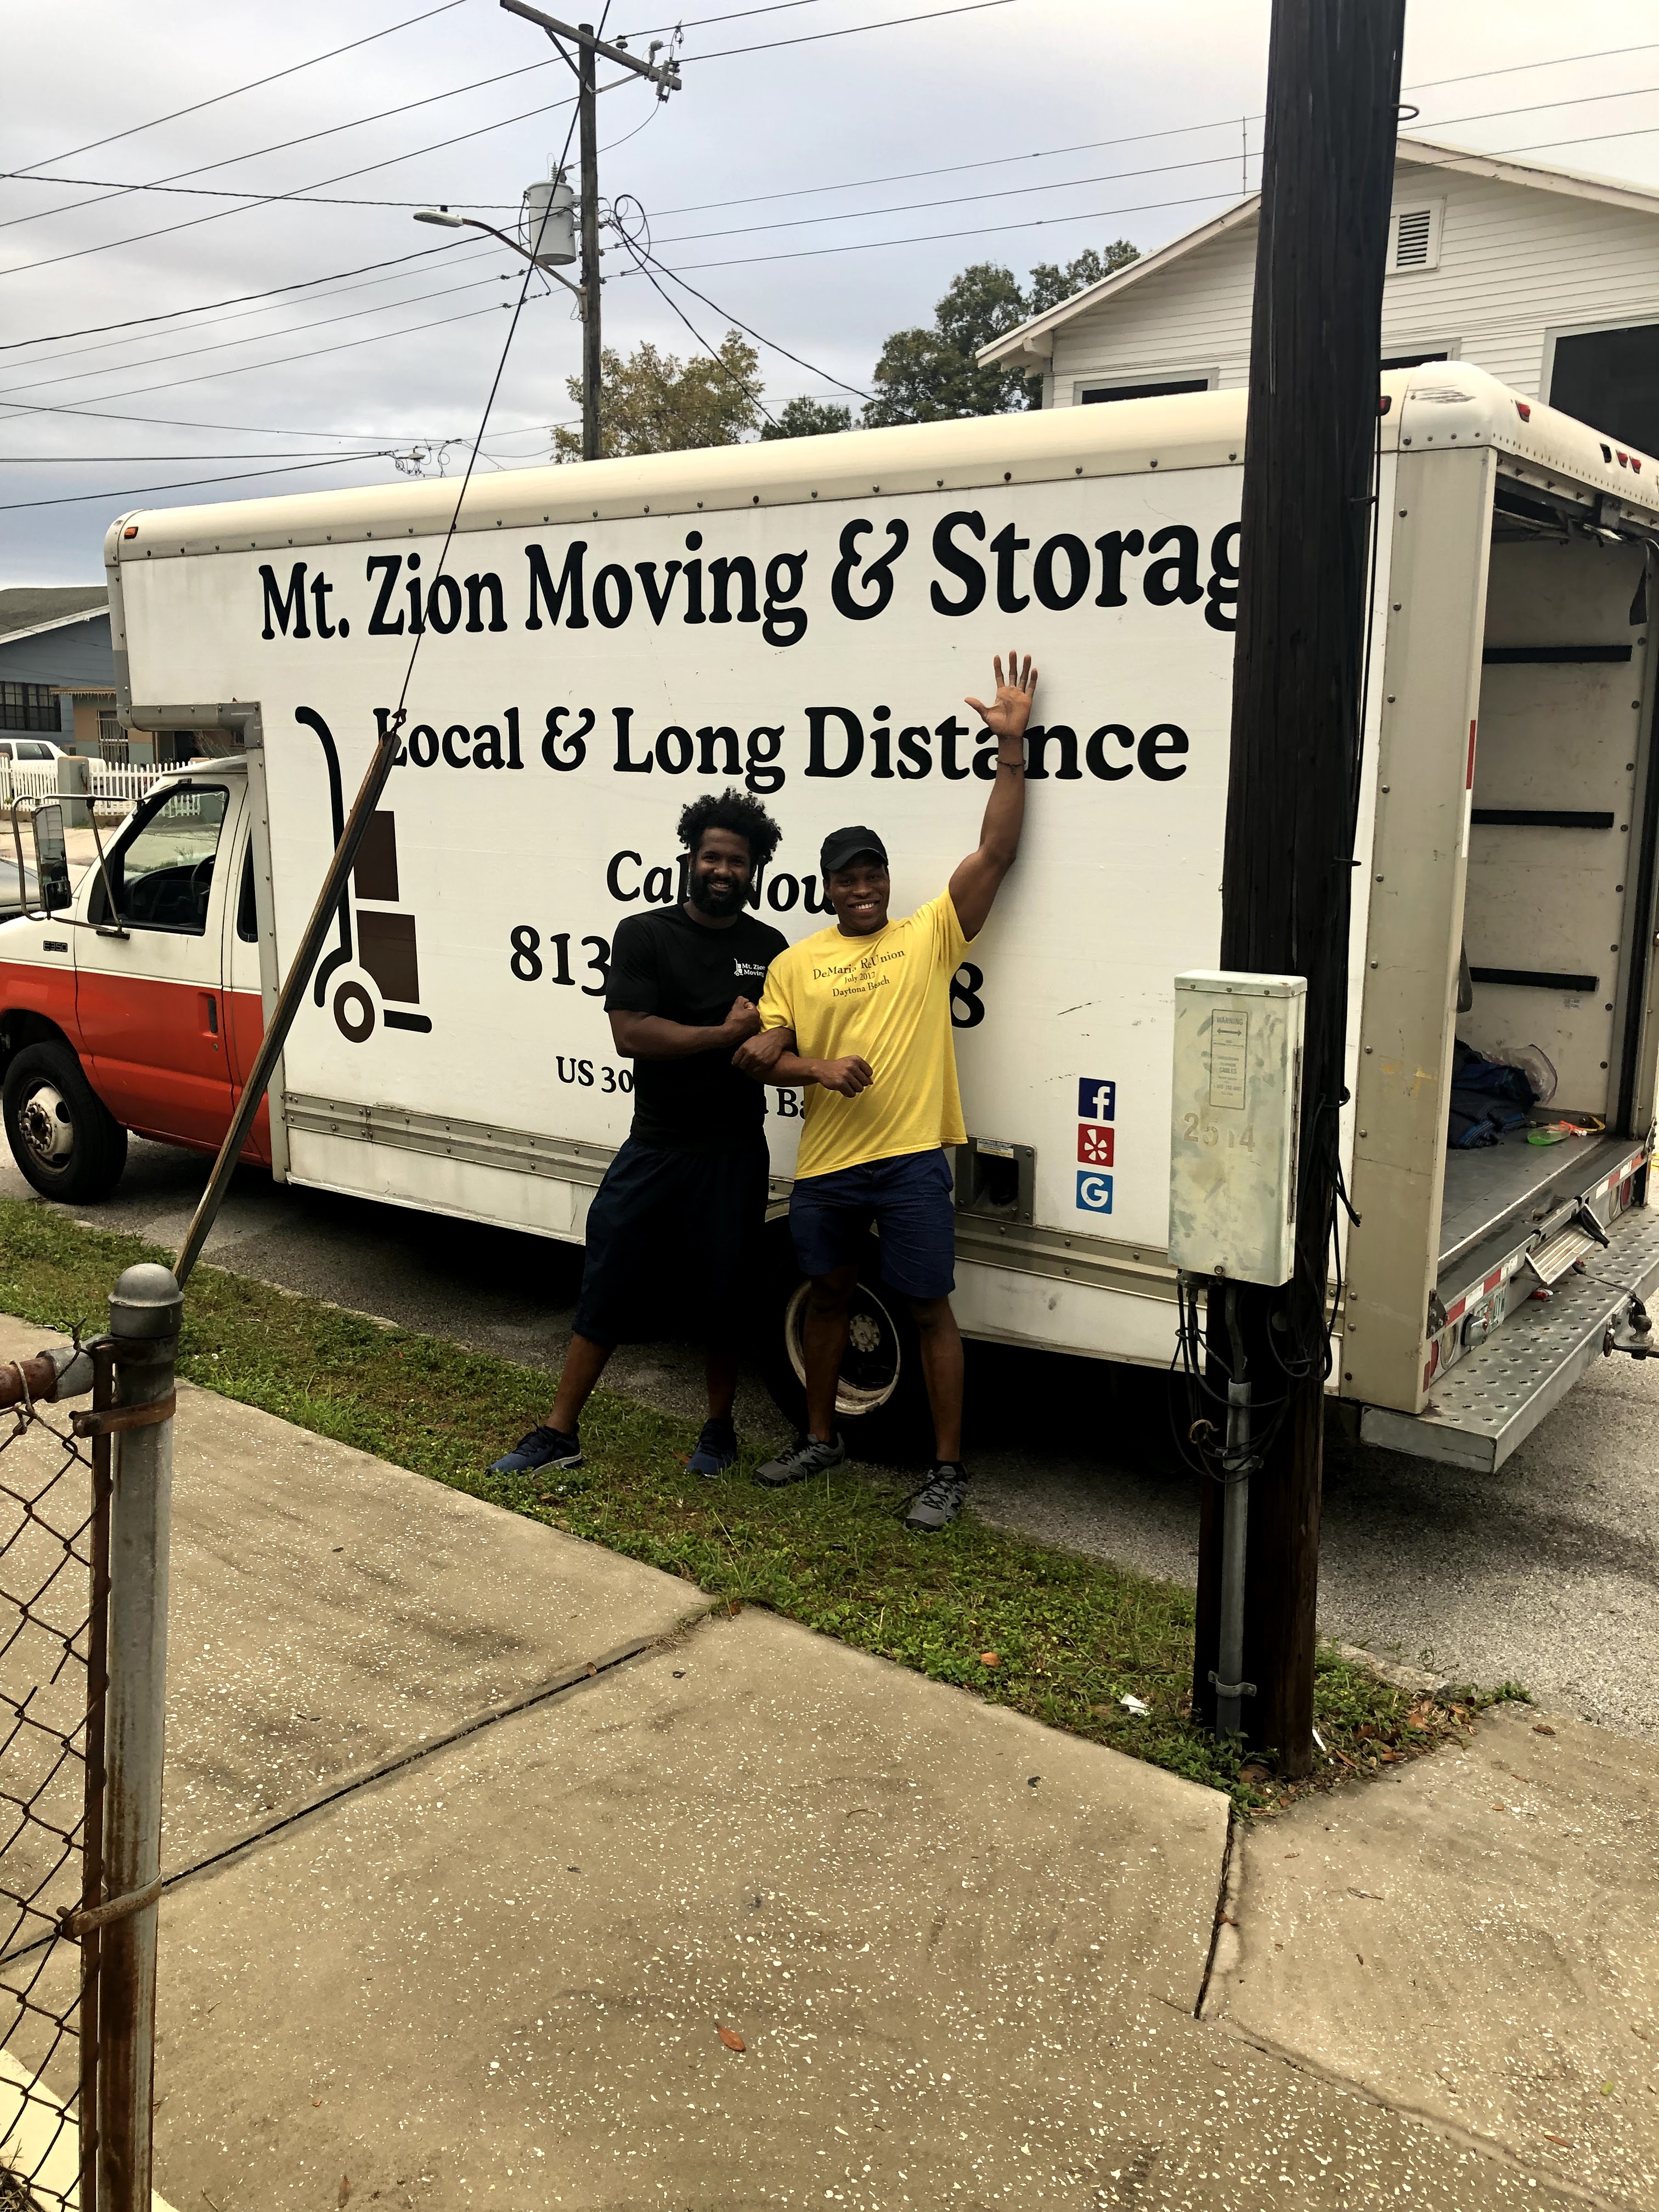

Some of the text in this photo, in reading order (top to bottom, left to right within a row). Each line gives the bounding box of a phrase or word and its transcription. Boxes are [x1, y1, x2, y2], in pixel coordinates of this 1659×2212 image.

[258, 510, 1242, 647] Mt. Zion Moving & Storag
[373, 704, 1189, 795] Local & Long Distance
[43, 941, 67, 952] E350
[844, 973, 858, 984] July
[832, 986, 866, 997] Daytona
[555, 1056, 594, 1087] US
